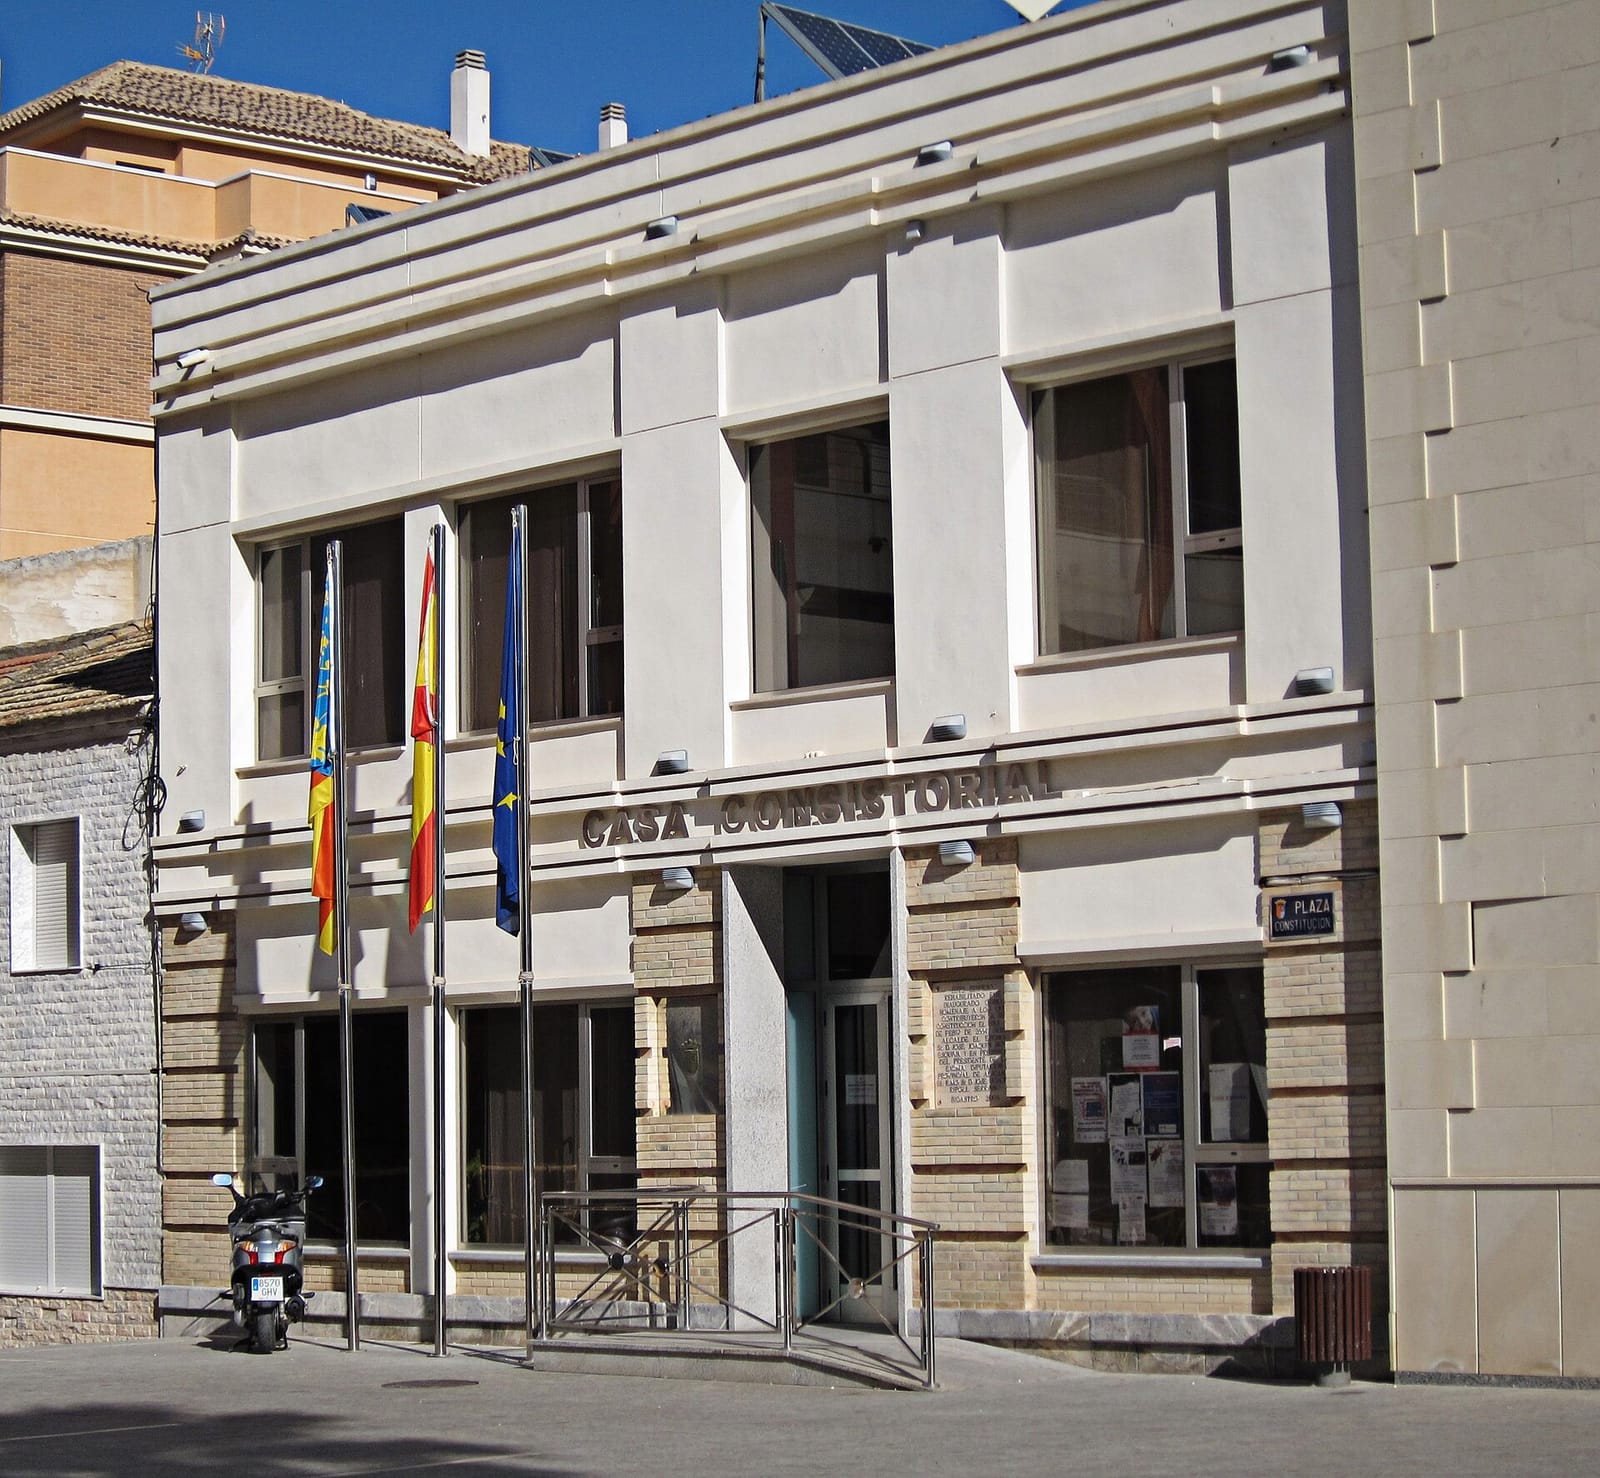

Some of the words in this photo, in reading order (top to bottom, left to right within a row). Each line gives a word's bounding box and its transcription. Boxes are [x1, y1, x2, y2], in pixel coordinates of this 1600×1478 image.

[583, 802, 690, 848] CASA
[721, 760, 1062, 834] CONSISTORIAL
[1294, 898, 1330, 914] PLAZA
[1274, 917, 1331, 932] CONSTITUCION
[259, 1279, 281, 1288] 8570
[261, 1287, 278, 1297] GHV
